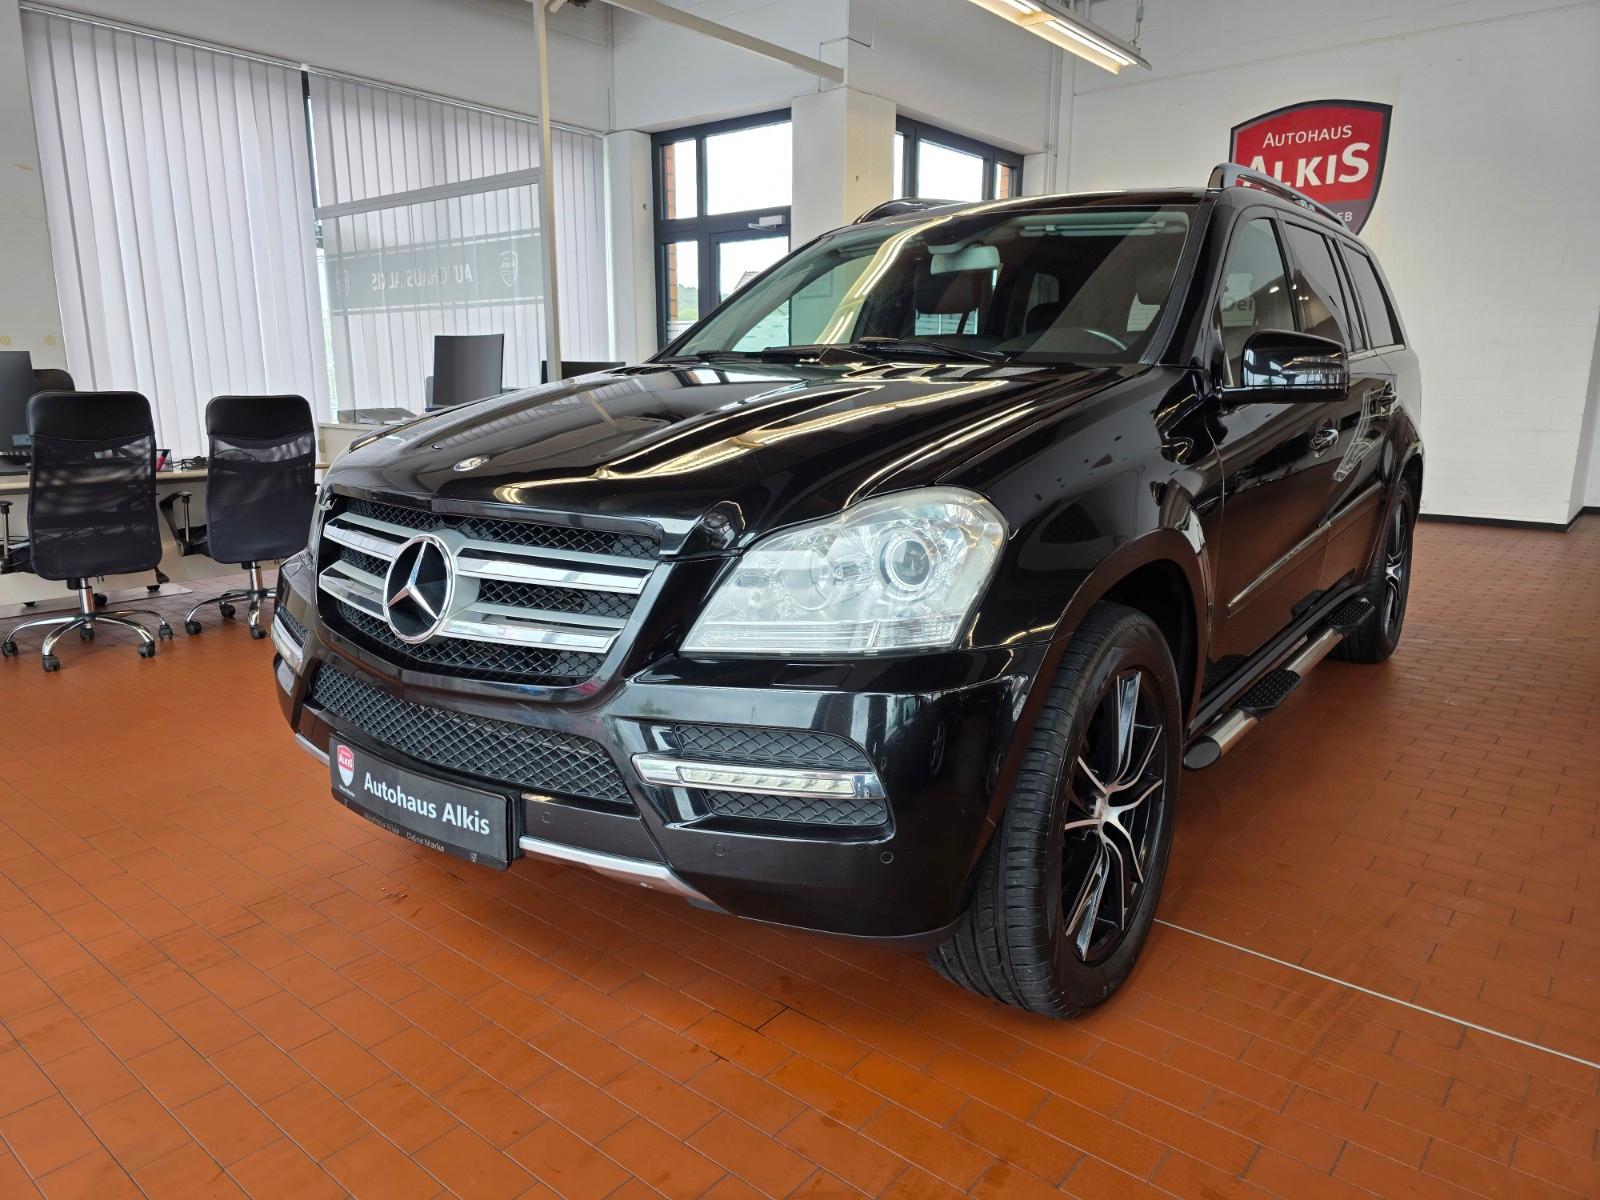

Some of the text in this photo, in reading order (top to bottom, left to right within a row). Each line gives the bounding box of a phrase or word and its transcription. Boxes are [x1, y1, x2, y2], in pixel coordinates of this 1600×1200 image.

[1262, 125, 1352, 148] AUTOHAUS
[1241, 142, 1370, 190] ALKIS
[364, 772, 490, 835] Autohaus Alkis
